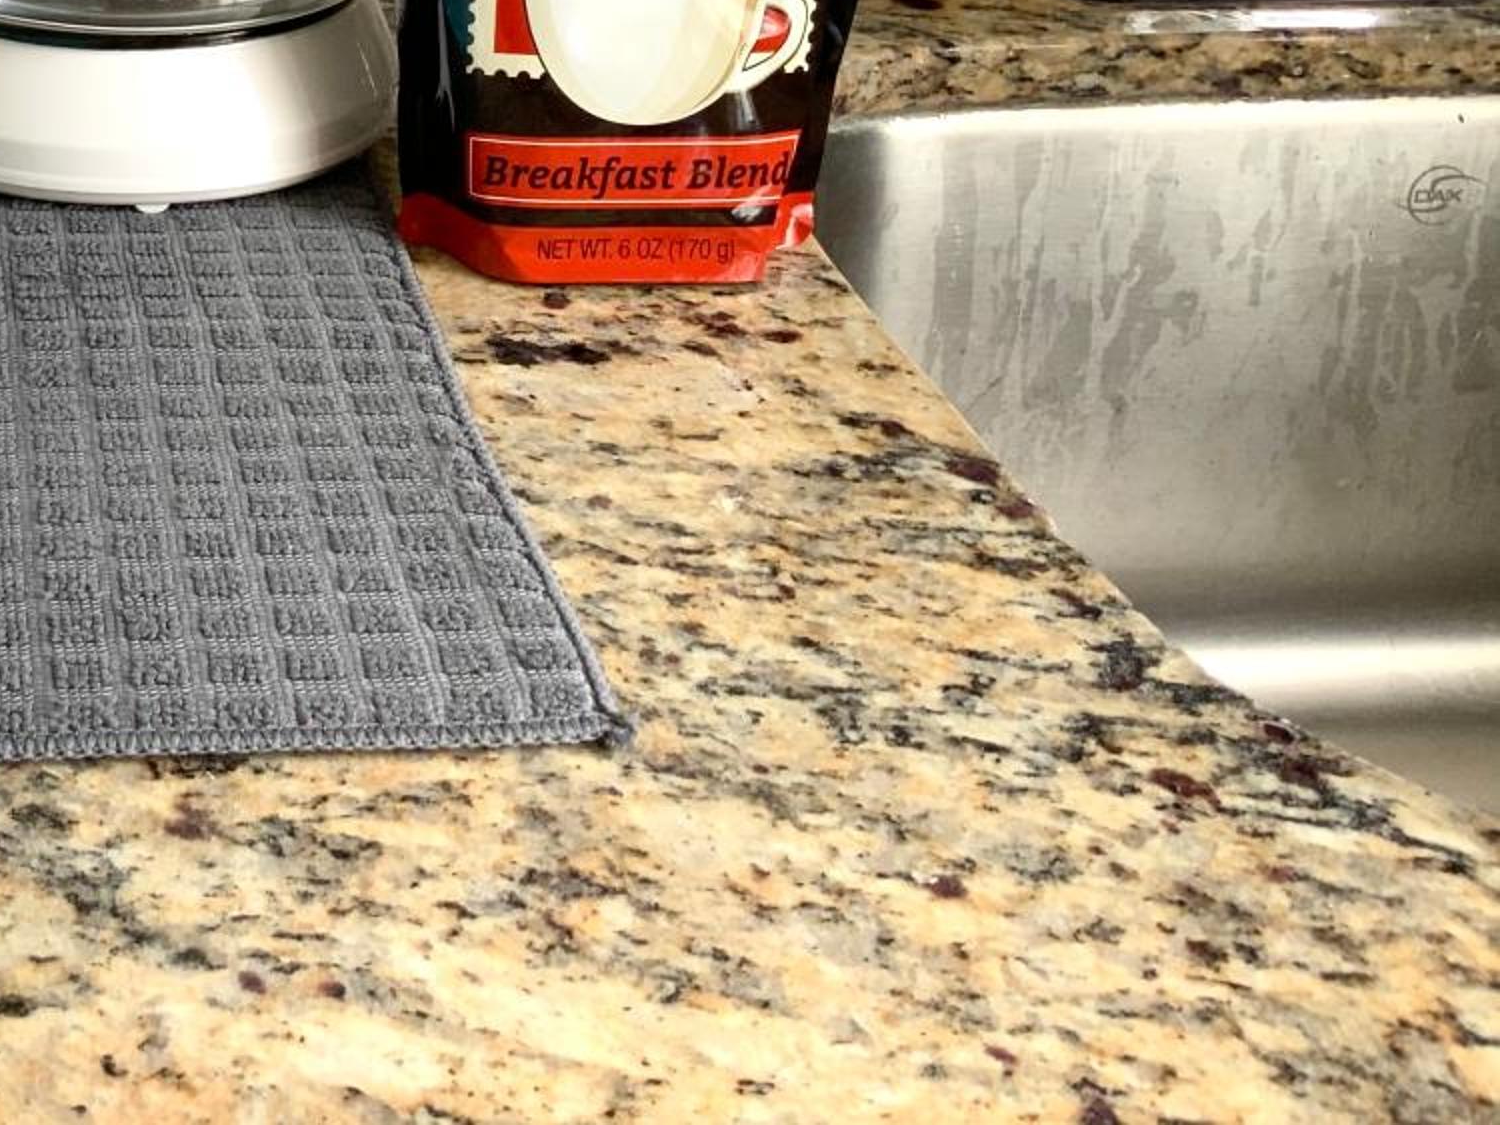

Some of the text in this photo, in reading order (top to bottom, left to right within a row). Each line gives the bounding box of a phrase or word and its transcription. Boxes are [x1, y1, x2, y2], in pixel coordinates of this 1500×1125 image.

[484, 151, 790, 200] Breakfast Blend
[537, 238, 735, 264] NET WT. 6 OZ (170 g)
